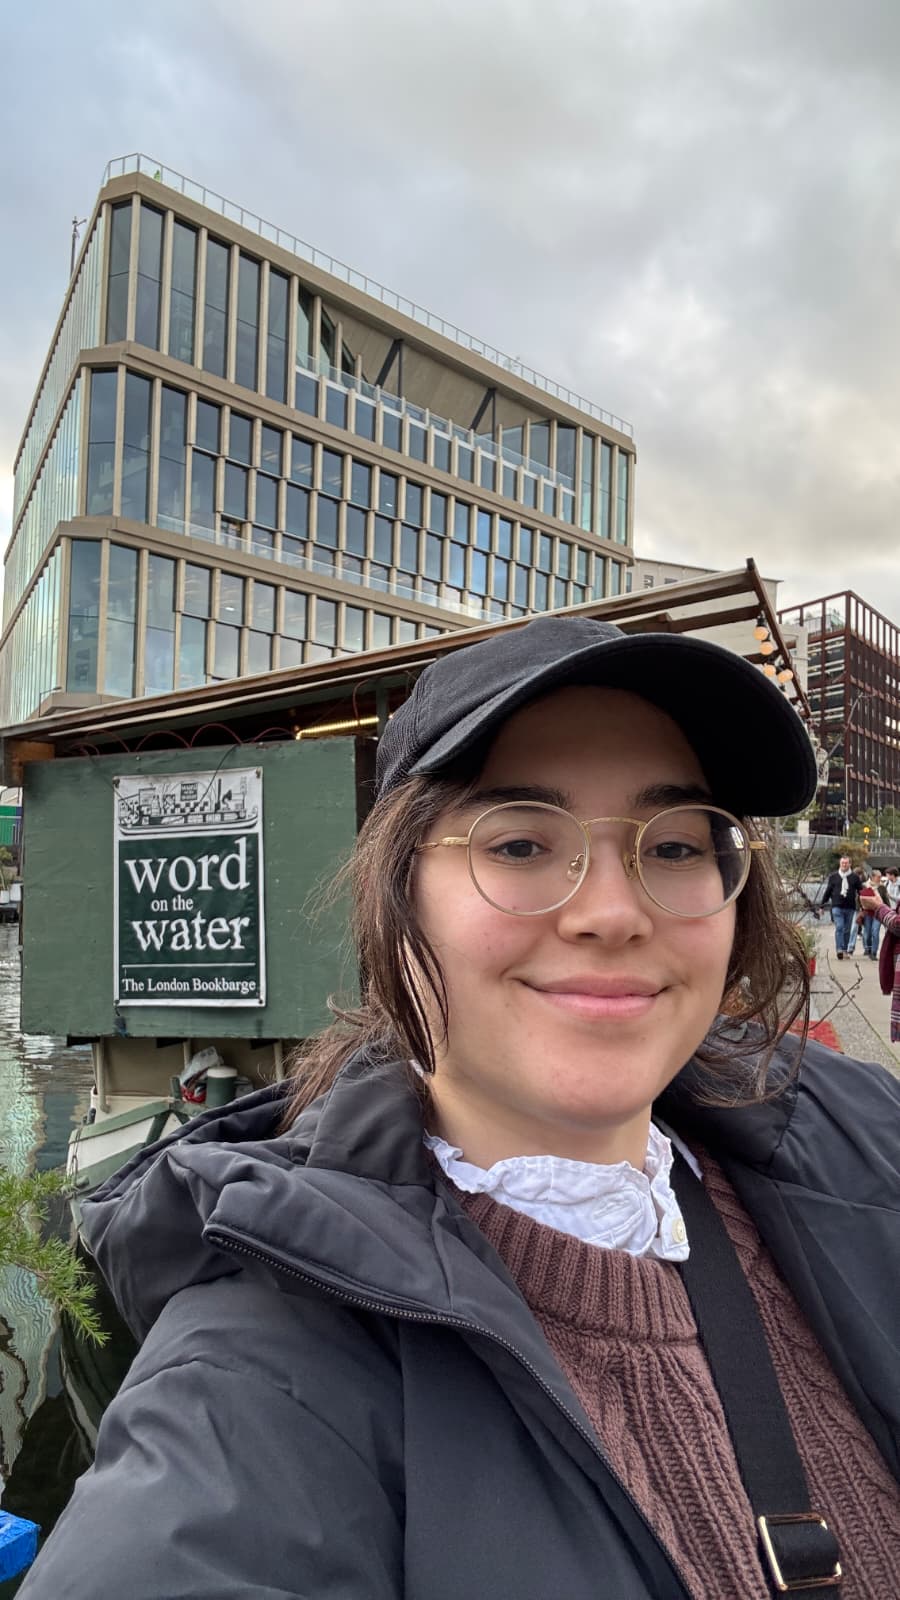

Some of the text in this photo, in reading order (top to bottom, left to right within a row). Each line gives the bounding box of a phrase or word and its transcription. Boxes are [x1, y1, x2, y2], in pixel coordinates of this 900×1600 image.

[124, 836, 250, 894] word
[151, 894, 194, 911] on the
[131, 910, 250, 951] water
[121, 977, 256, 995] The London Bookbarge
